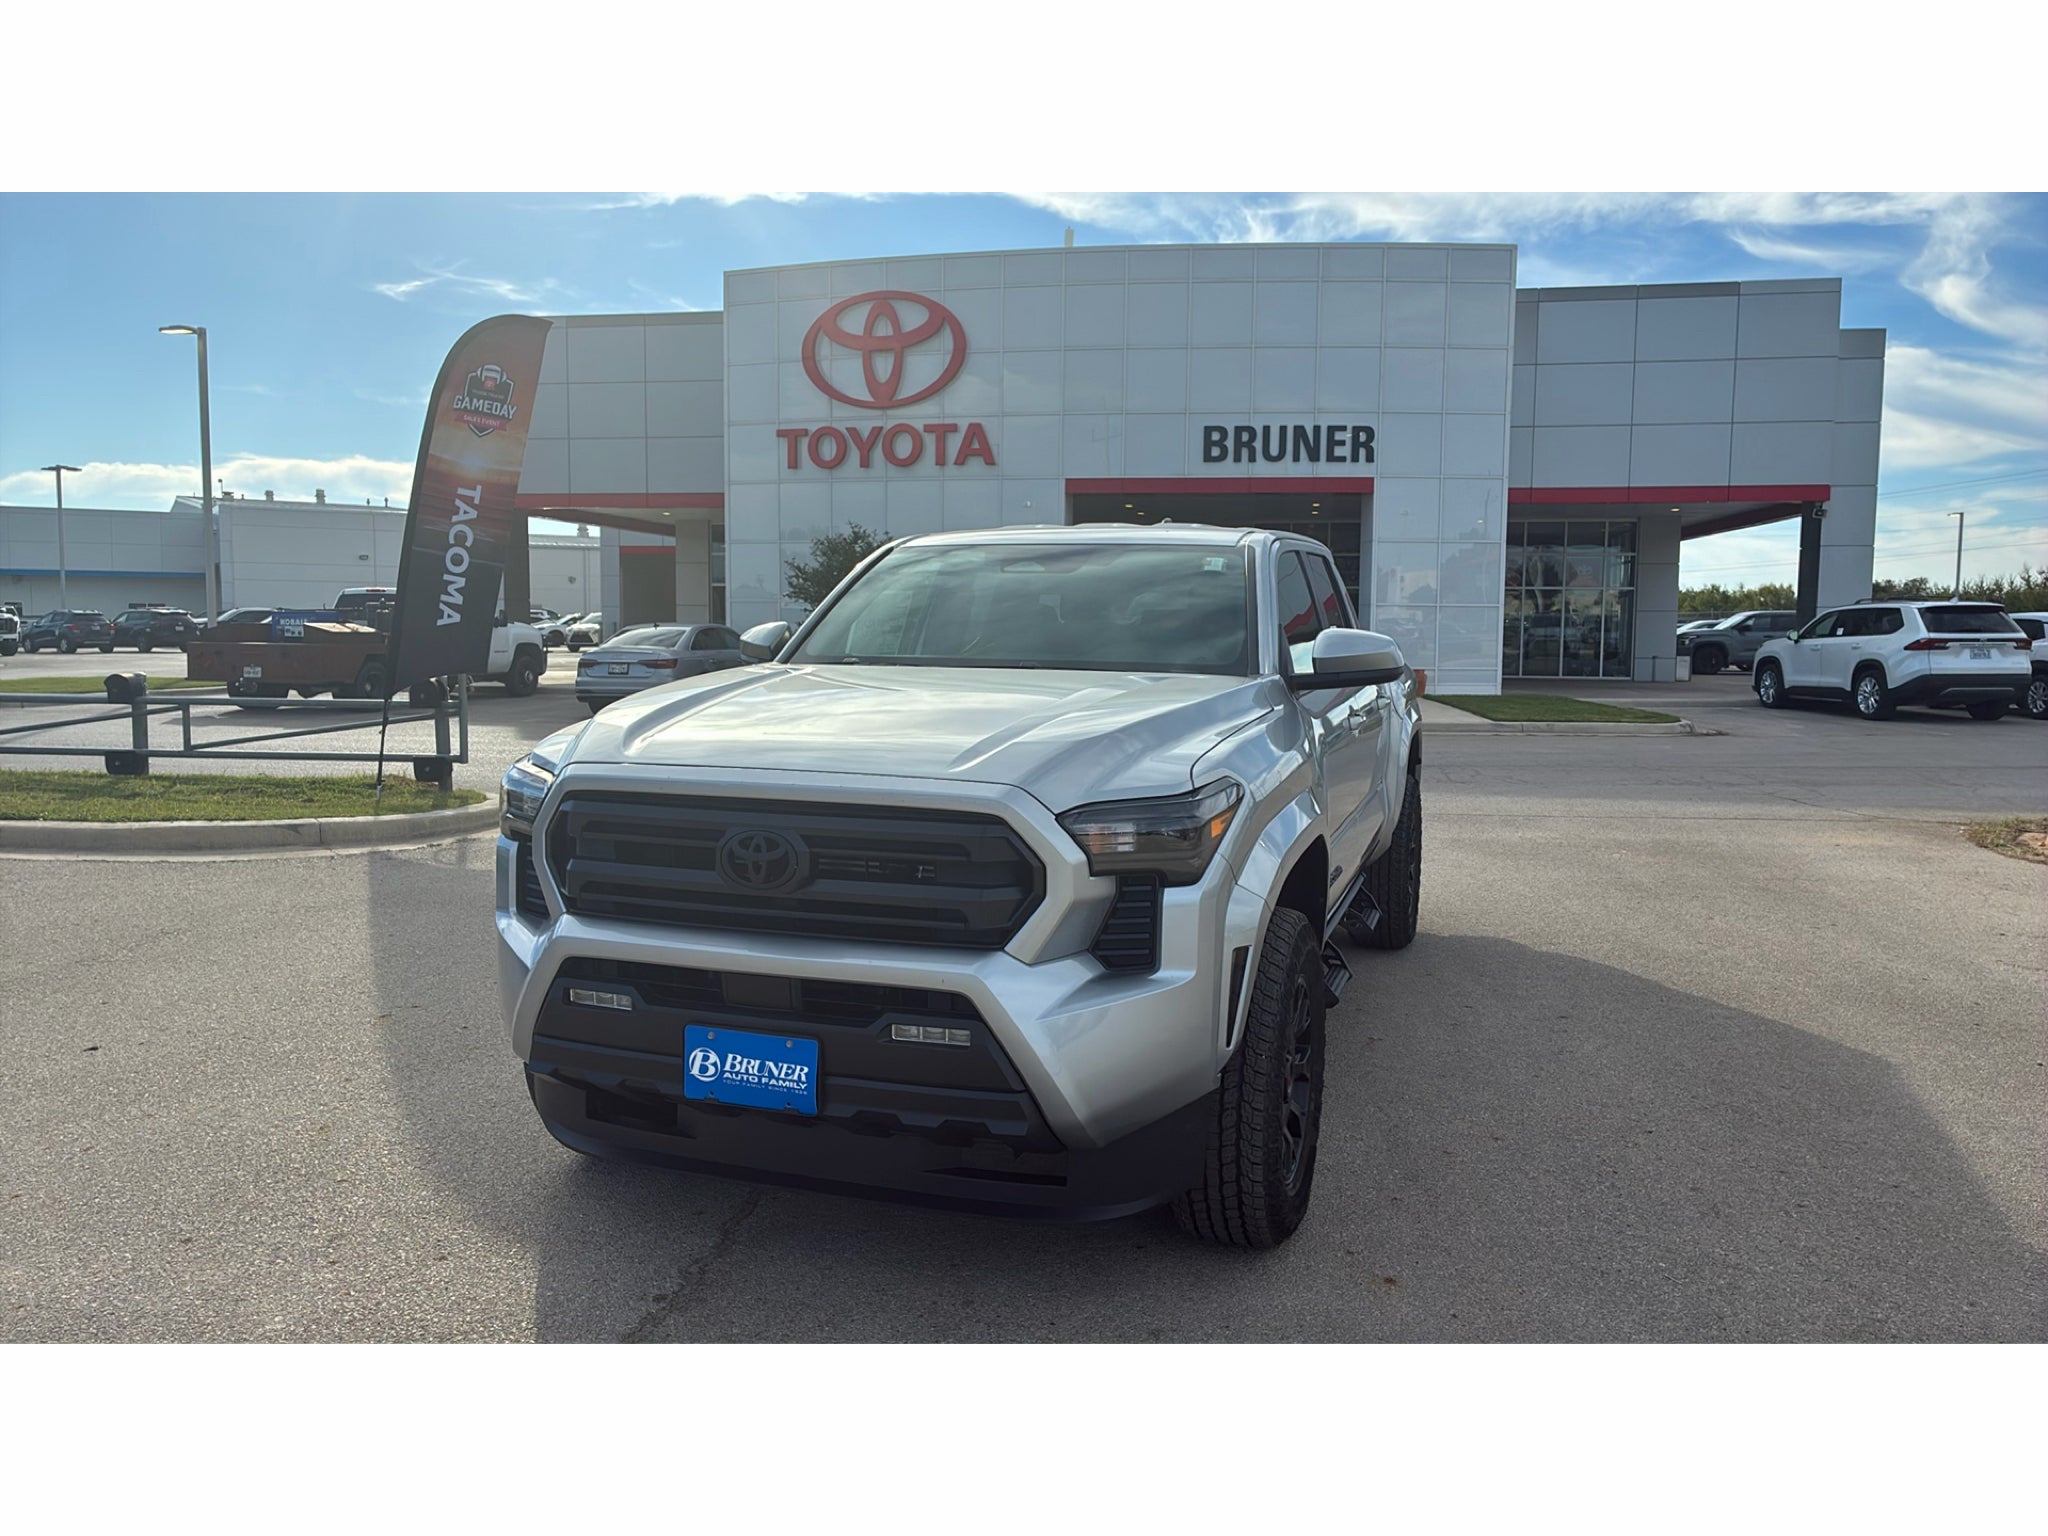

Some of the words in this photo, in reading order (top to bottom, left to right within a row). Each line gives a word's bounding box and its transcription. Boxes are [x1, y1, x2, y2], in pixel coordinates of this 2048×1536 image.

[453, 395, 517, 419] GAMEDAY
[482, 418, 500, 429] EVENT
[776, 422, 996, 470] TOYOTA
[1203, 425, 1375, 463] BRUNER
[436, 484, 482, 627] TACOMA
[723, 1053, 809, 1082] BRUNER
[723, 1072, 758, 1083] AUTO
[761, 1077, 808, 1090] FAMILY
